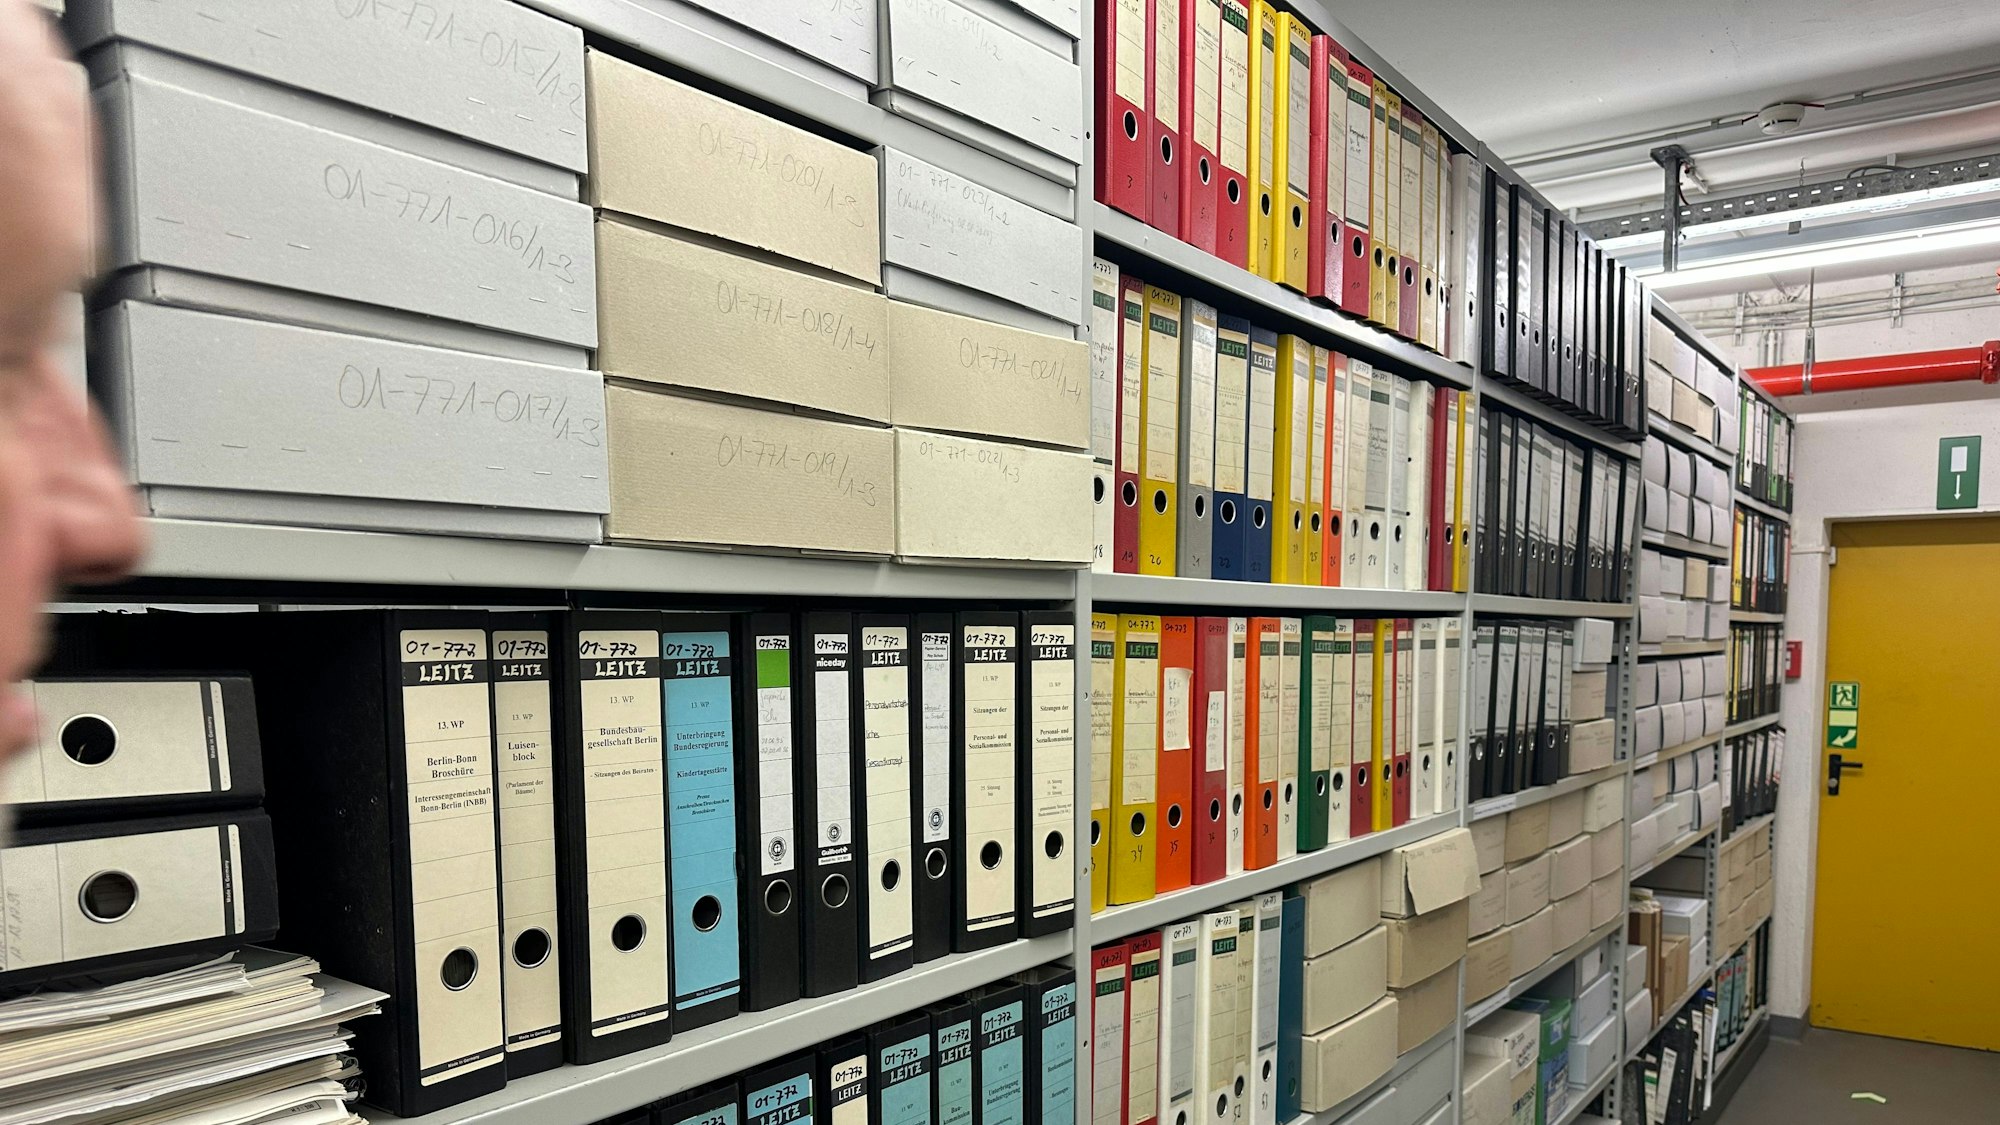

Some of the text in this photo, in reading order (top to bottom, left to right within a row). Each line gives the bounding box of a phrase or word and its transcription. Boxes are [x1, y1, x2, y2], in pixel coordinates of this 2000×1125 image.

[1127, 175, 1133, 188] 3
[1228, 228, 1234, 241] 6
[1152, 317, 1176, 333] LEITZ
[1221, 342, 1245, 356] LEITZ
[1254, 354, 1274, 368] LEITZ
[866, 635, 899, 648] 01-772
[966, 633, 1006, 646] 01-772
[974, 649, 1007, 661] LEITZ
[1039, 647, 1068, 659] LEITZ
[1130, 645, 1156, 656] LEITZ
[816, 657, 846, 668] niceday
[871, 652, 901, 665] LEITZ
[419, 664, 474, 682] LEITZ
[502, 664, 542, 677] LEITZ
[595, 660, 647, 677] LEITZ
[676, 661, 720, 676] LEITZ
[610, 695, 634, 704] 13. WP
[973, 707, 998, 715] Sitzungen
[438, 720, 465, 730] 13. WP
[600, 727, 646, 736] Bundesbau-
[677, 730, 725, 740] Unterbringung
[508, 741, 540, 751] Luisen-
[587, 735, 658, 749] gesellschaft Berlin
[673, 740, 729, 751] Bundesregierung
[968, 741, 1012, 750] Sozialkommission
[427, 754, 477, 767] Berlin-Bonn
[512, 752, 536, 762] block
[431, 767, 474, 779] Broschüre
[621, 768, 631, 776] des
[676, 767, 728, 778] Kindertagesstätte
[533, 779, 544, 787] der
[415, 787, 491, 803] Interessengemeinschaft
[420, 798, 487, 813] Bonn-Berlin (INBB)
[1214, 939, 1235, 951] LEITZ
[1134, 964, 1157, 977] LEITZ
[1100, 981, 1121, 994] LEITZ
[1048, 1006, 1070, 1025] LEITZ
[535, 1029, 551, 1037] Germany
[989, 1026, 1016, 1045] LEITZ
[884, 1048, 918, 1065] 01-772
[941, 1045, 971, 1065] LEITZ
[890, 1061, 922, 1084] LEITZ
[755, 1085, 798, 1109] 01-772
[838, 1083, 862, 1100] LEITZ
[760, 1104, 800, 1125] LEITZ
